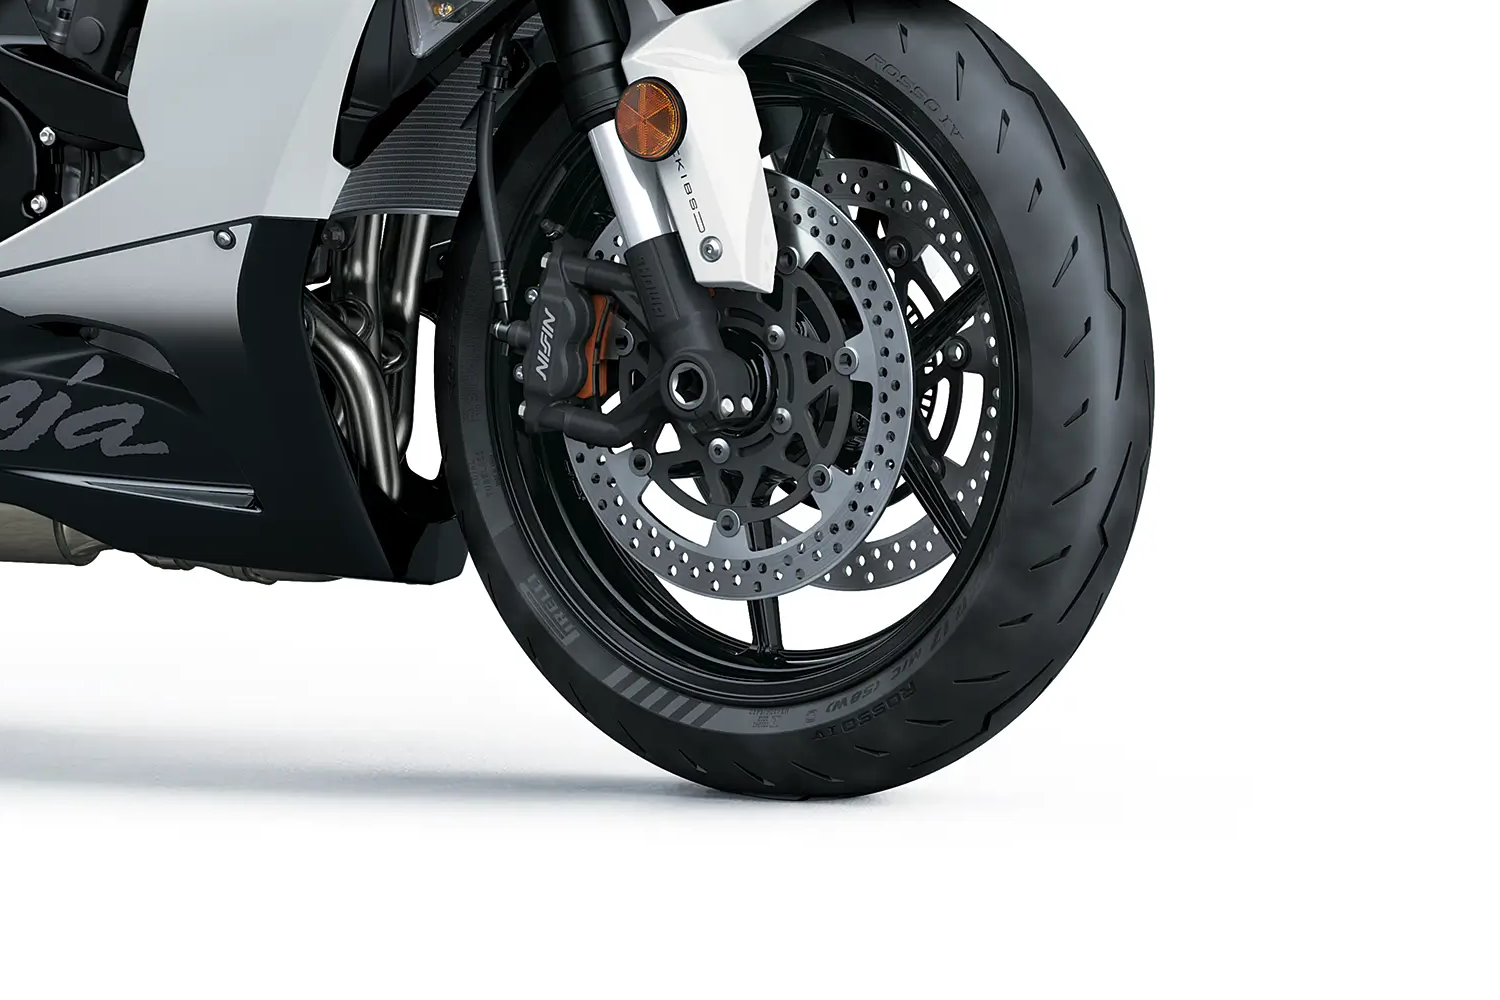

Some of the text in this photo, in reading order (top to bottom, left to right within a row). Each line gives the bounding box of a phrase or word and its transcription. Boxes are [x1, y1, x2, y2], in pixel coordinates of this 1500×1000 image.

[865, 52, 964, 140] ROSSO IV
[675, 158, 698, 211] KIBS
[518, 572, 580, 647] PIRELLI
[840, 679, 916, 734] ROSSO
